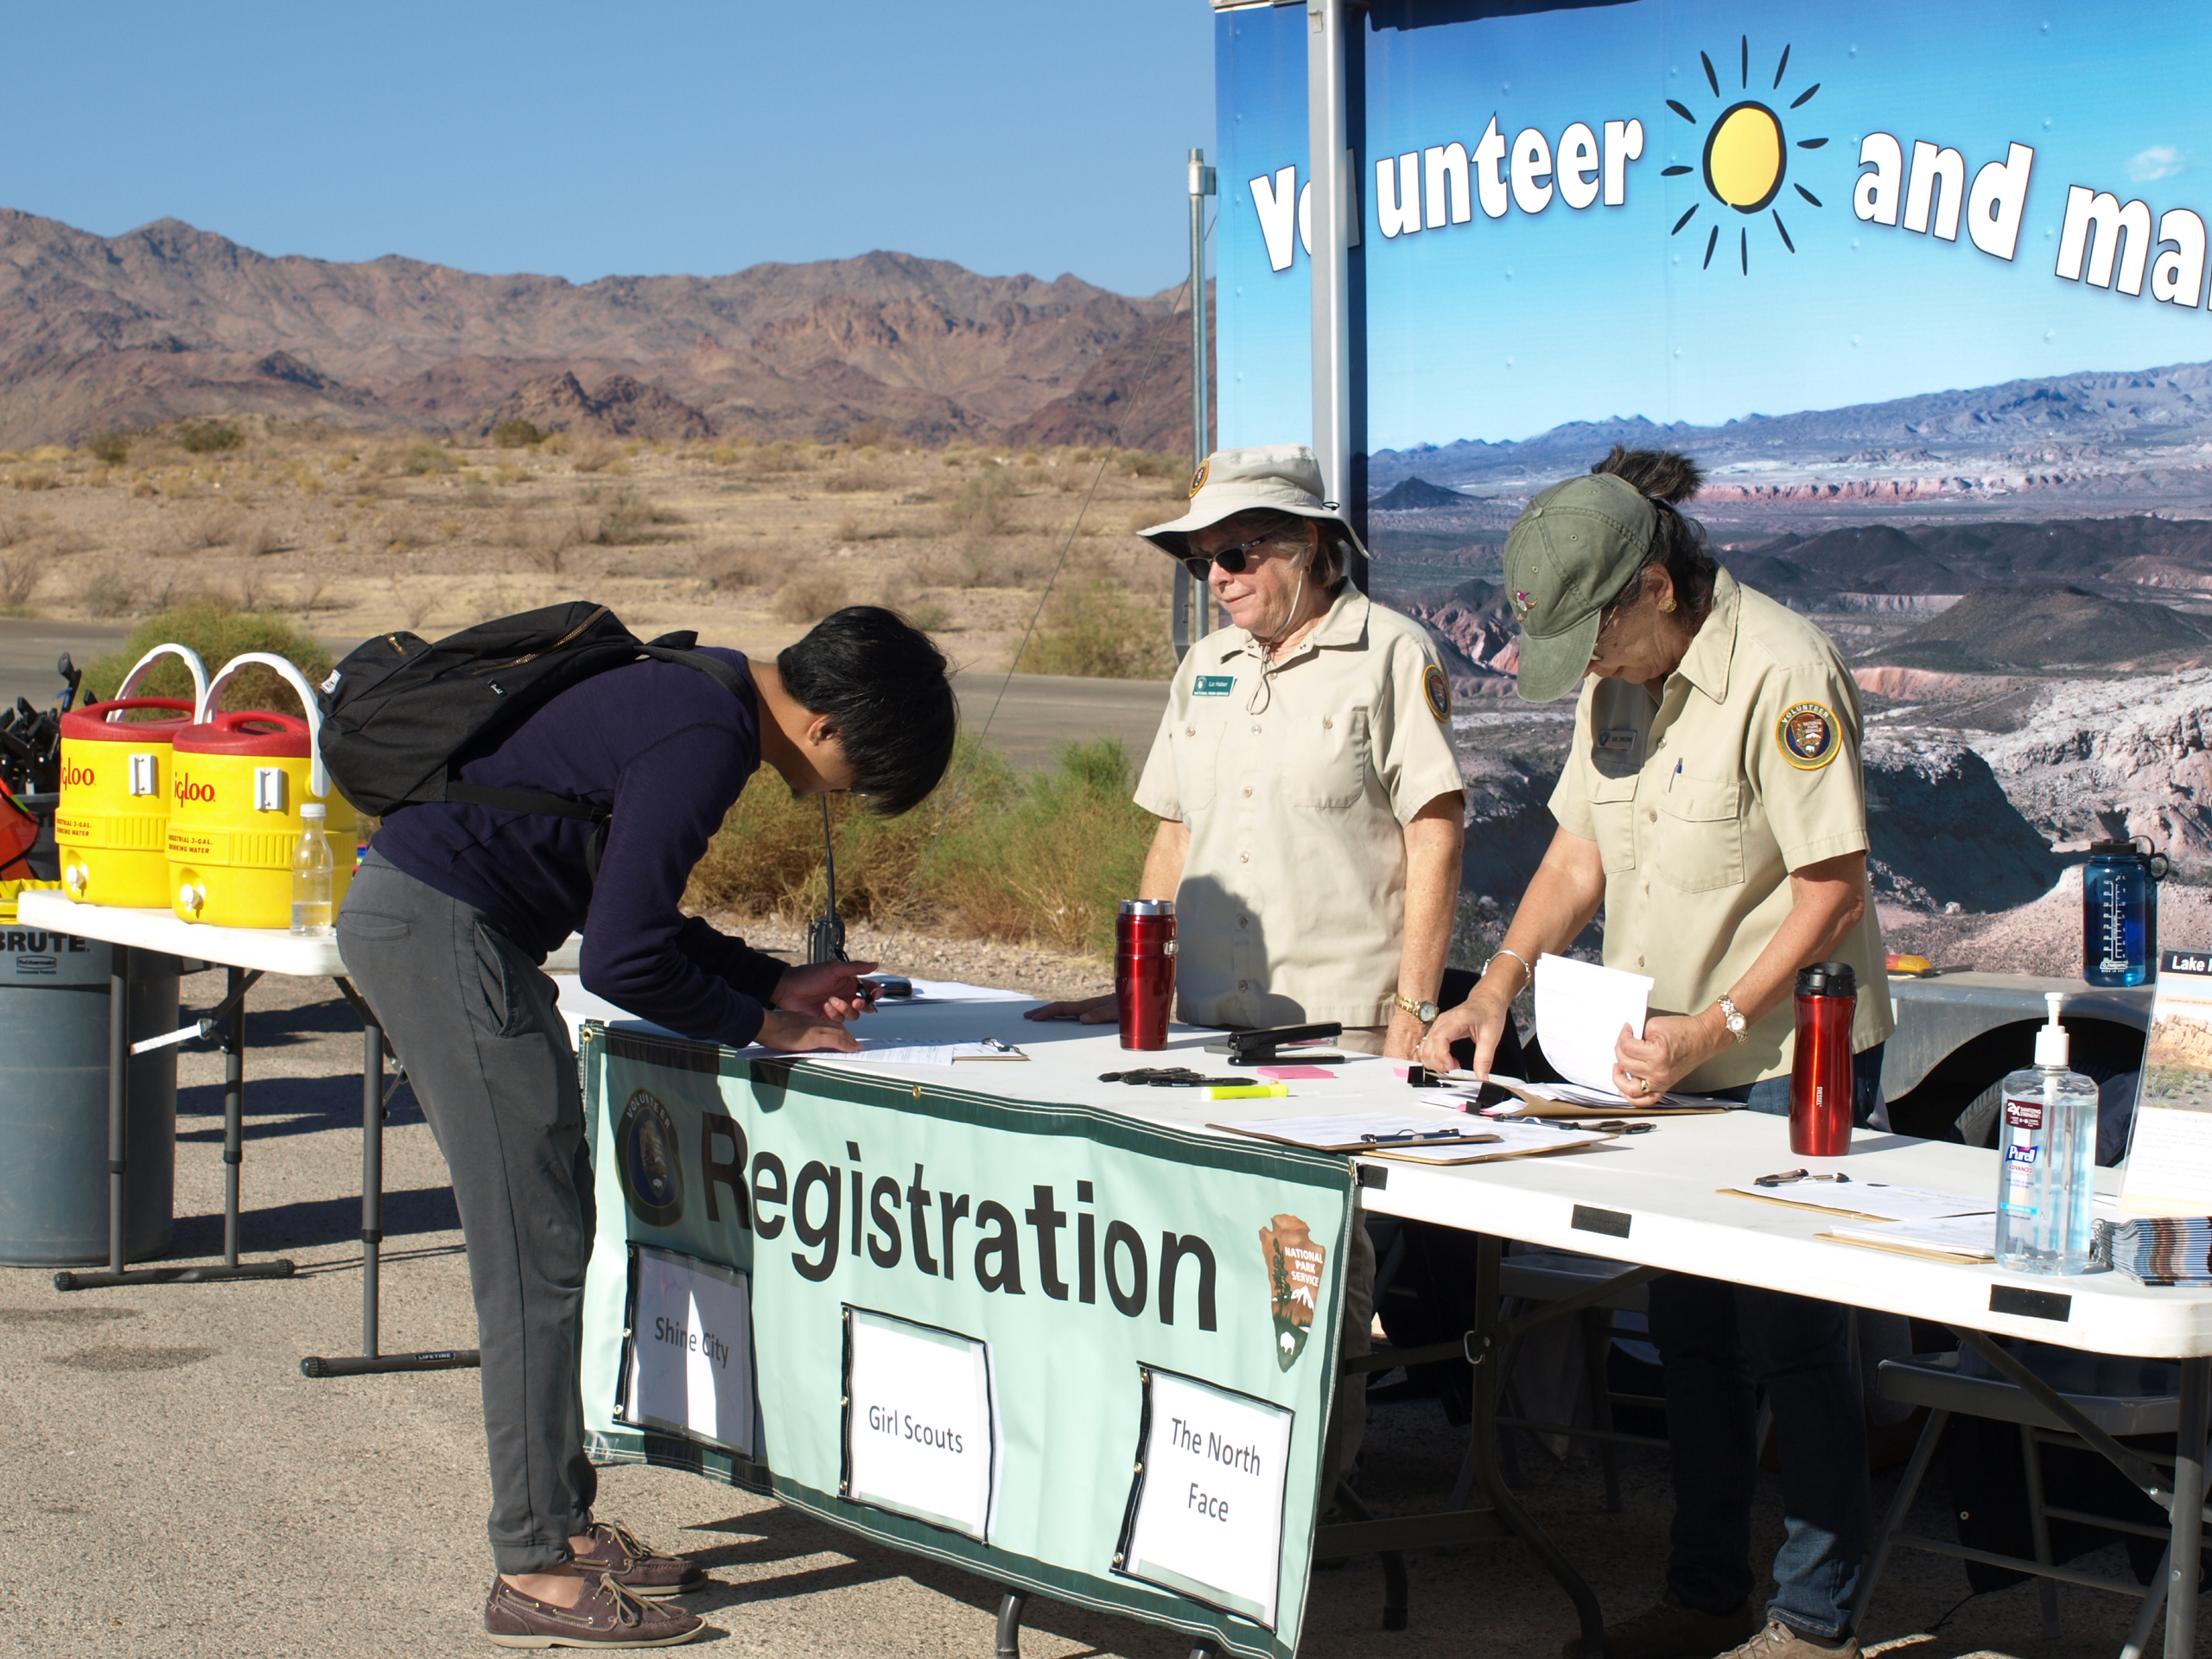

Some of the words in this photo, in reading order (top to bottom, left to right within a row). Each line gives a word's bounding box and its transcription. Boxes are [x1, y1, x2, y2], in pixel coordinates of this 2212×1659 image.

[1249, 111, 1643, 272] Vlunteer
[1853, 131, 2035, 262] and
[2055, 184, 2212, 312] ma
[1782, 705, 1829, 723] VOLUNTEER
[175, 772, 215, 809] igloo
[2171, 955, 2205, 972] Lake
[626, 1092, 671, 1128] VOLUNTEER
[2008, 1164, 2033, 1173] ADVANCED
[701, 1110, 1217, 1332] Registration
[1284, 1246, 1324, 1264] NATIONAL
[1294, 1260, 1316, 1274] PARK
[1291, 1270, 1319, 1287] SERVICE
[654, 1316, 697, 1352] Shine
[702, 1332, 729, 1370] City
[868, 1404, 898, 1436] Girl
[904, 1414, 963, 1453] Scouts
[1172, 1416, 1202, 1454] The
[1207, 1431, 1261, 1477] North
[1188, 1481, 1229, 1522] Face
